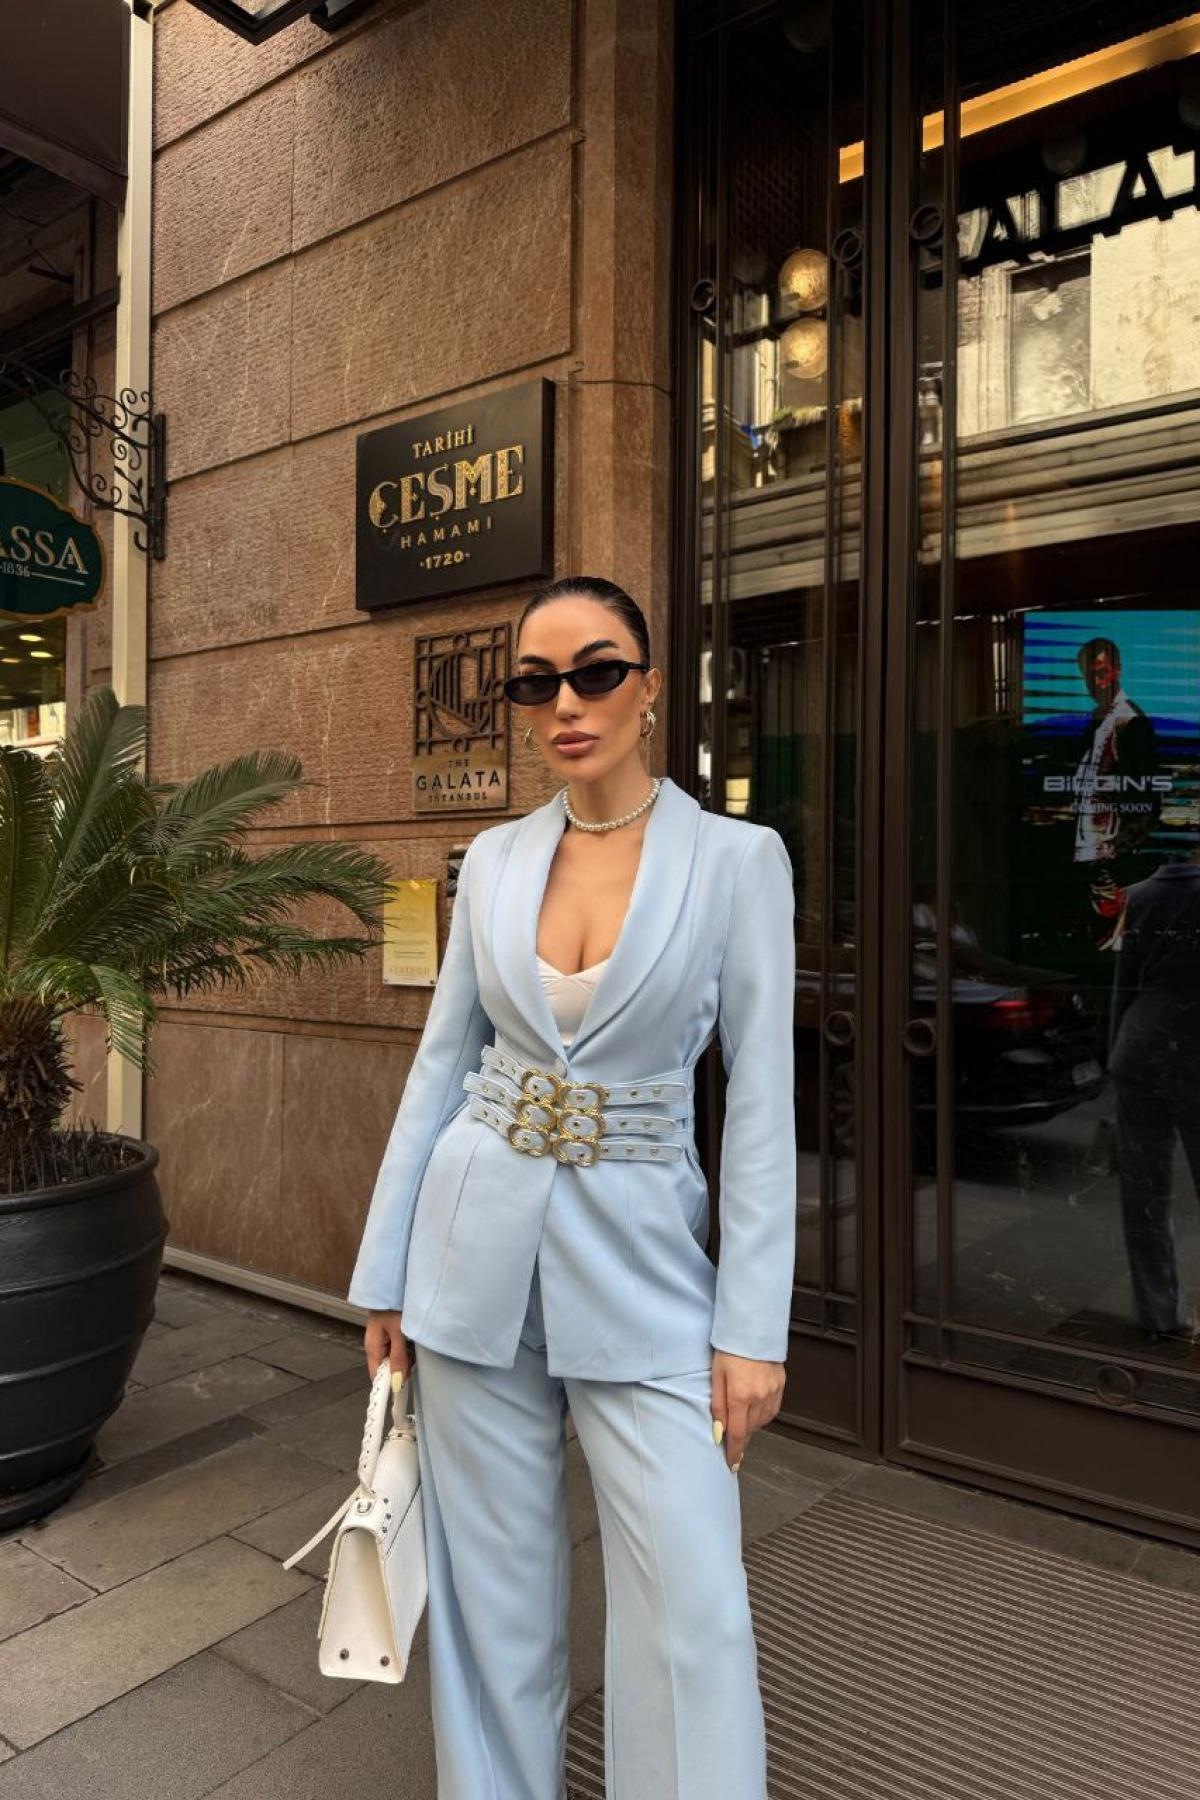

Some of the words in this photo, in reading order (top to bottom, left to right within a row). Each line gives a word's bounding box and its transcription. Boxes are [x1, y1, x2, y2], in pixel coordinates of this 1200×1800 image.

[413, 424, 474, 459] TARİHİ
[369, 445, 525, 534] ÇEŞME
[400, 516, 492, 549] HAMAMI
[0, 525, 89, 575] SSA
[448, 758, 470, 768] THE
[416, 769, 501, 791] GALATA
[1119, 802, 1153, 814] SOON
